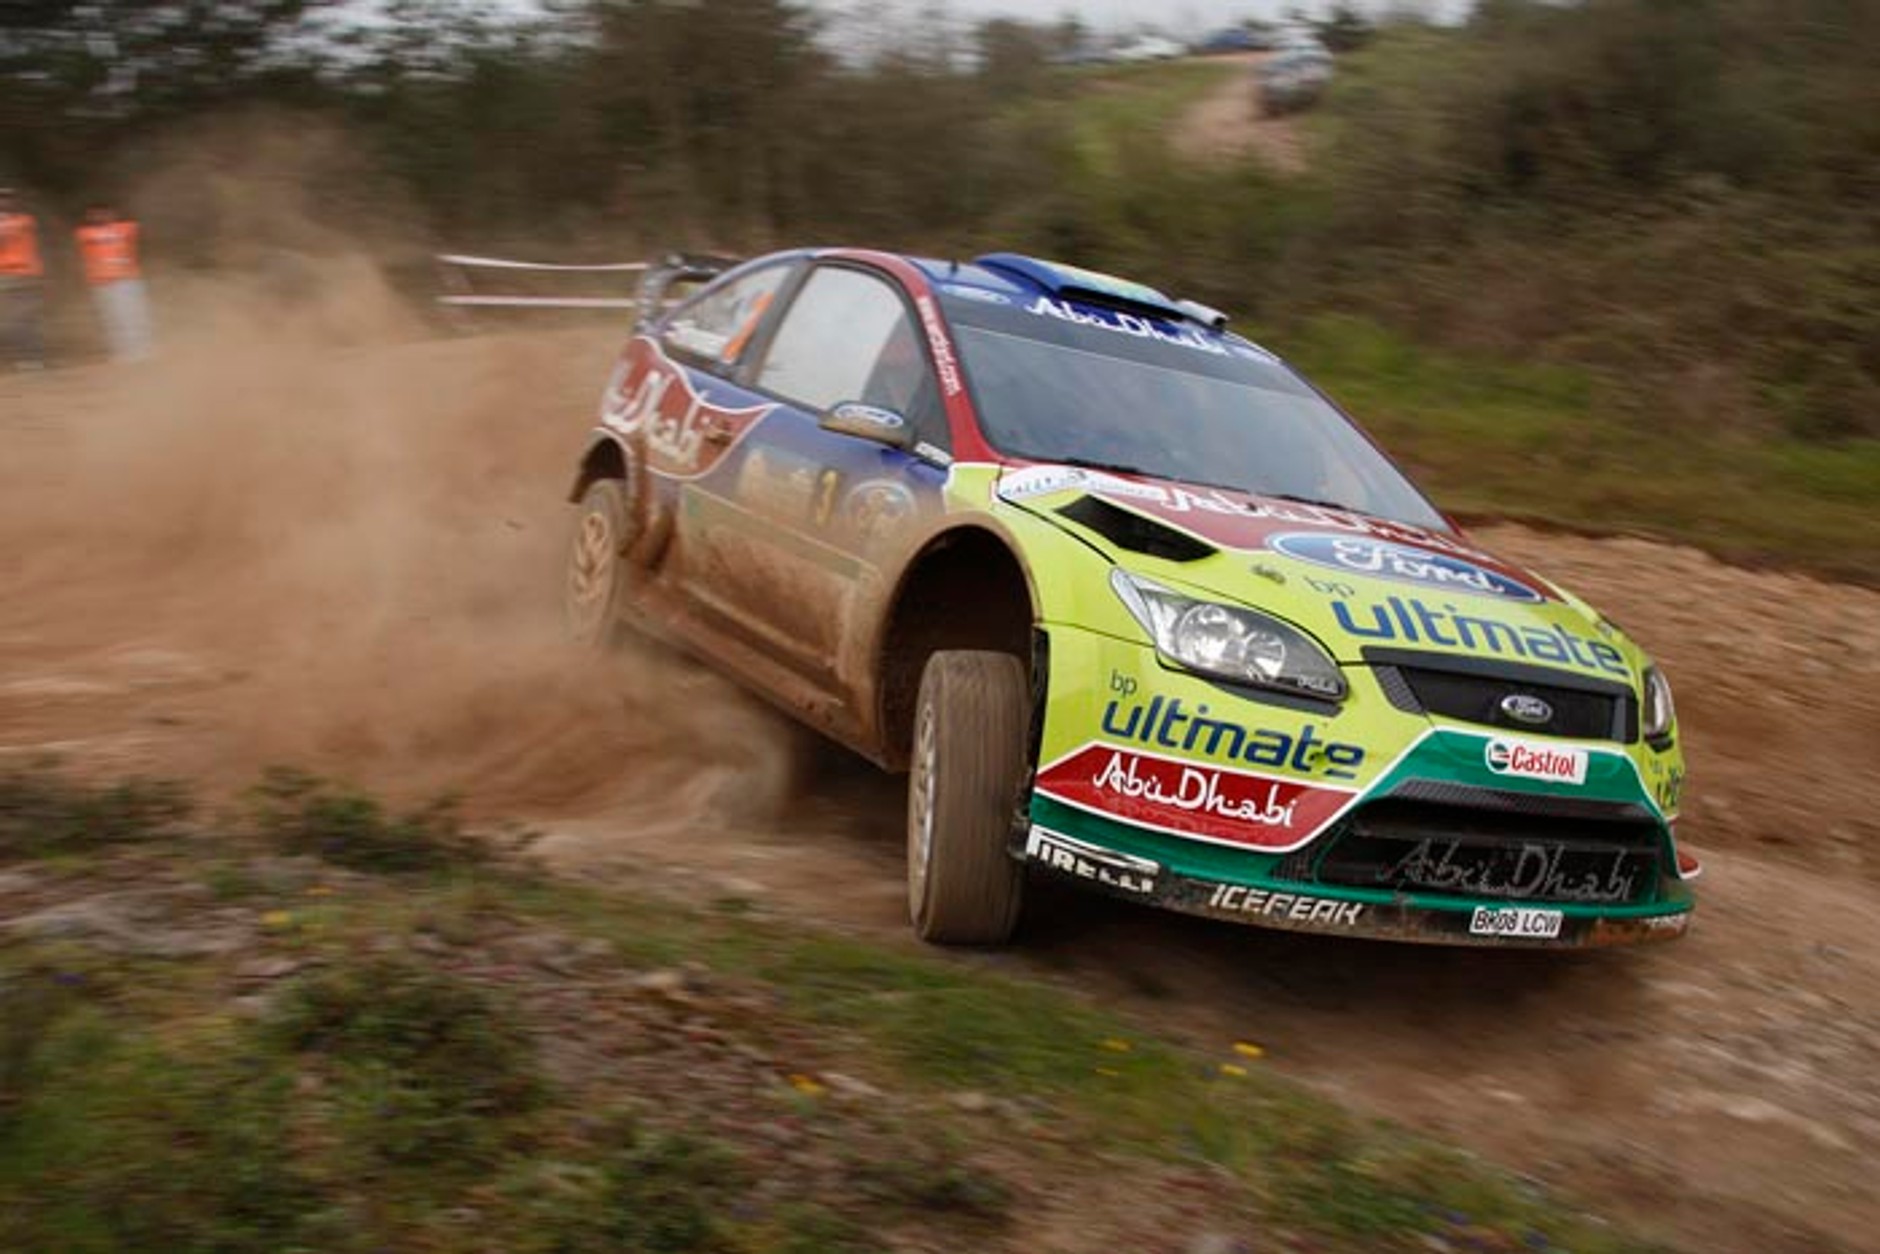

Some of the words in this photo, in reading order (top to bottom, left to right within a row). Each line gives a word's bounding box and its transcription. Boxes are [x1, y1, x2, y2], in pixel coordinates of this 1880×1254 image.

[1304, 576, 1355, 598] bp
[1332, 539, 1504, 592] Ford
[1331, 596, 1632, 678] ultimate
[1110, 668, 1138, 698] bp
[1102, 694, 1366, 780] ultimate
[1511, 745, 1576, 777] Castrol
[1093, 752, 1170, 805] Abu
[1170, 768, 1297, 828] Dhabi
[1026, 823, 1160, 893] PIRELLI
[1376, 837, 1500, 893] Abu
[1500, 842, 1638, 900] Dhabi
